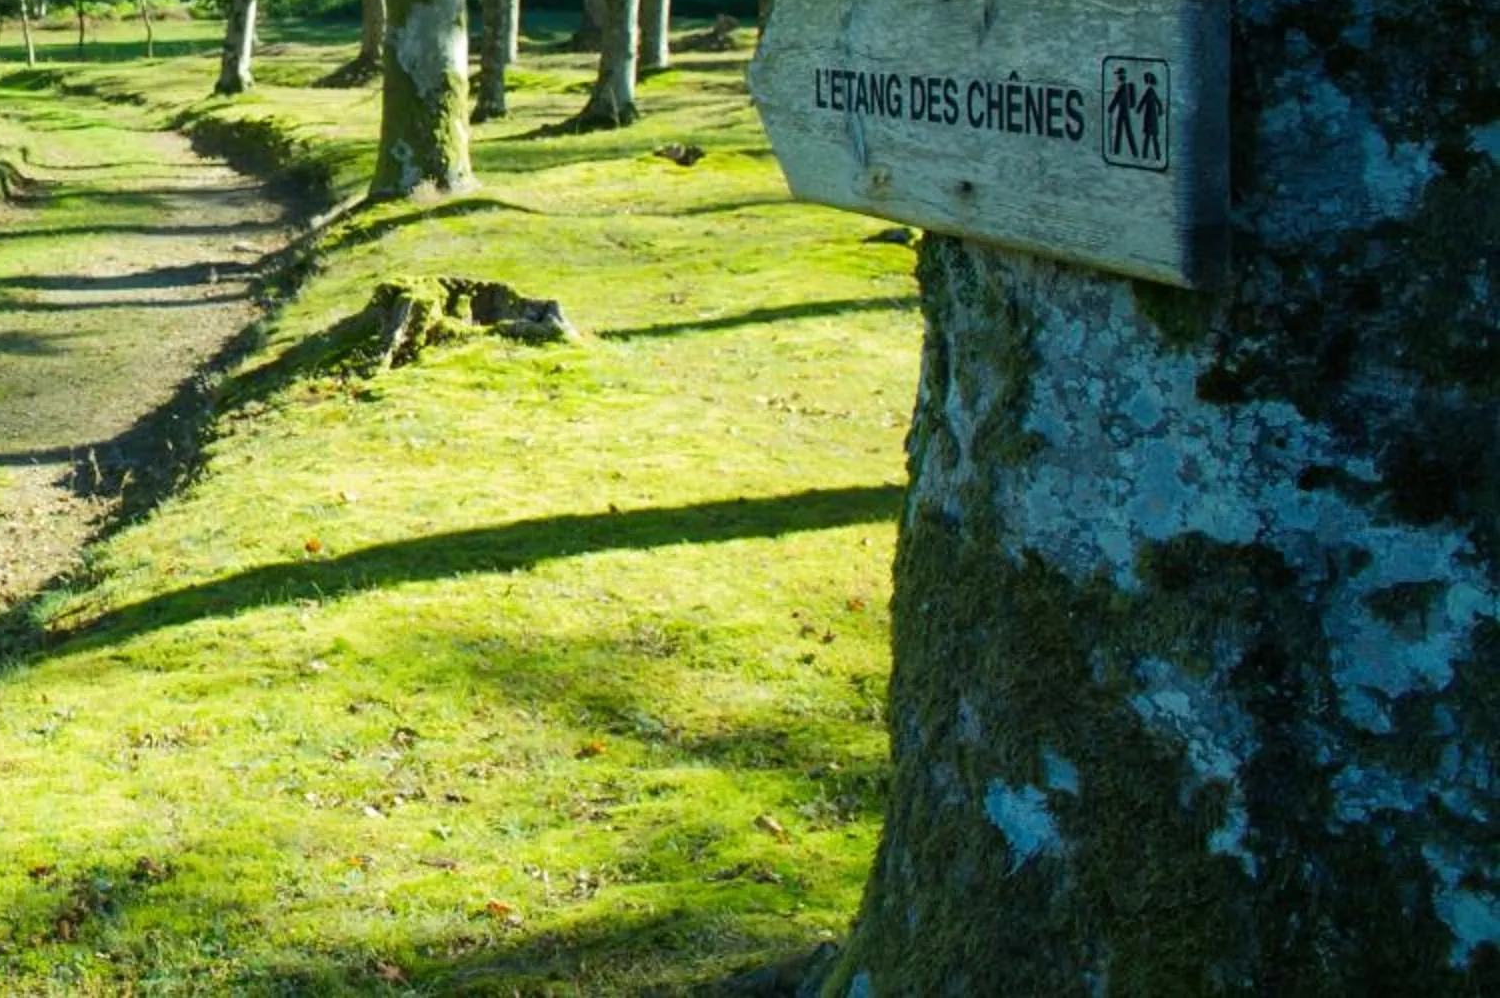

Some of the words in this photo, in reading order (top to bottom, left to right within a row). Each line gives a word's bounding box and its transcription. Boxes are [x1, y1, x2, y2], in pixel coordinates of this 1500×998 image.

[815, 68, 903, 118] L'ETANG
[909, 76, 959, 124] DES
[966, 70, 1085, 142] CHÊNES
